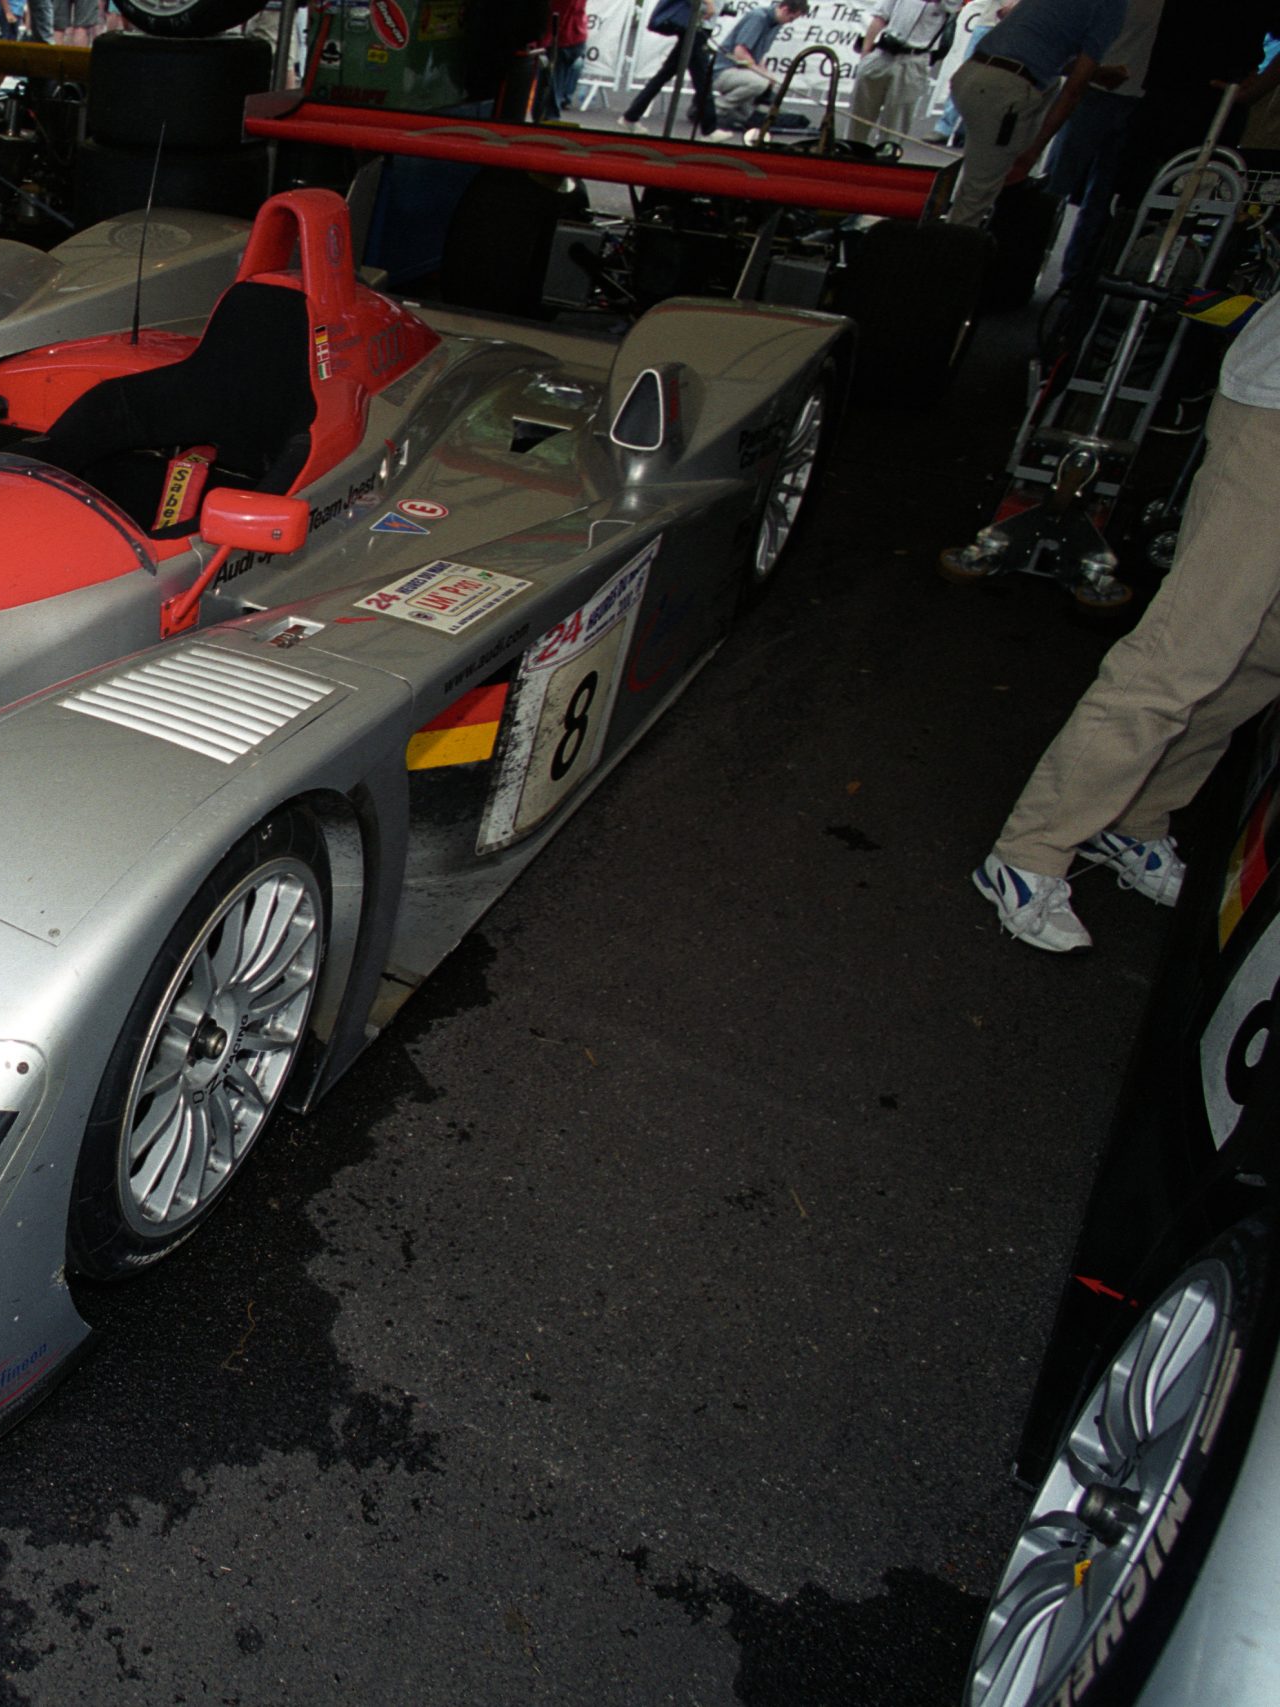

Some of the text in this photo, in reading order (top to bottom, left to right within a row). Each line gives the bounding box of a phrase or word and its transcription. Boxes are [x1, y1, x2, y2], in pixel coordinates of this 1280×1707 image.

[831, 4, 866, 22] THE
[765, 56, 806, 75] nsa
[308, 471, 377, 533] Team Joest
[366, 592, 400, 611] 24
[537, 607, 585, 663] 24
[550, 670, 599, 782] 8
[222, 1013, 249, 1074] RACING
